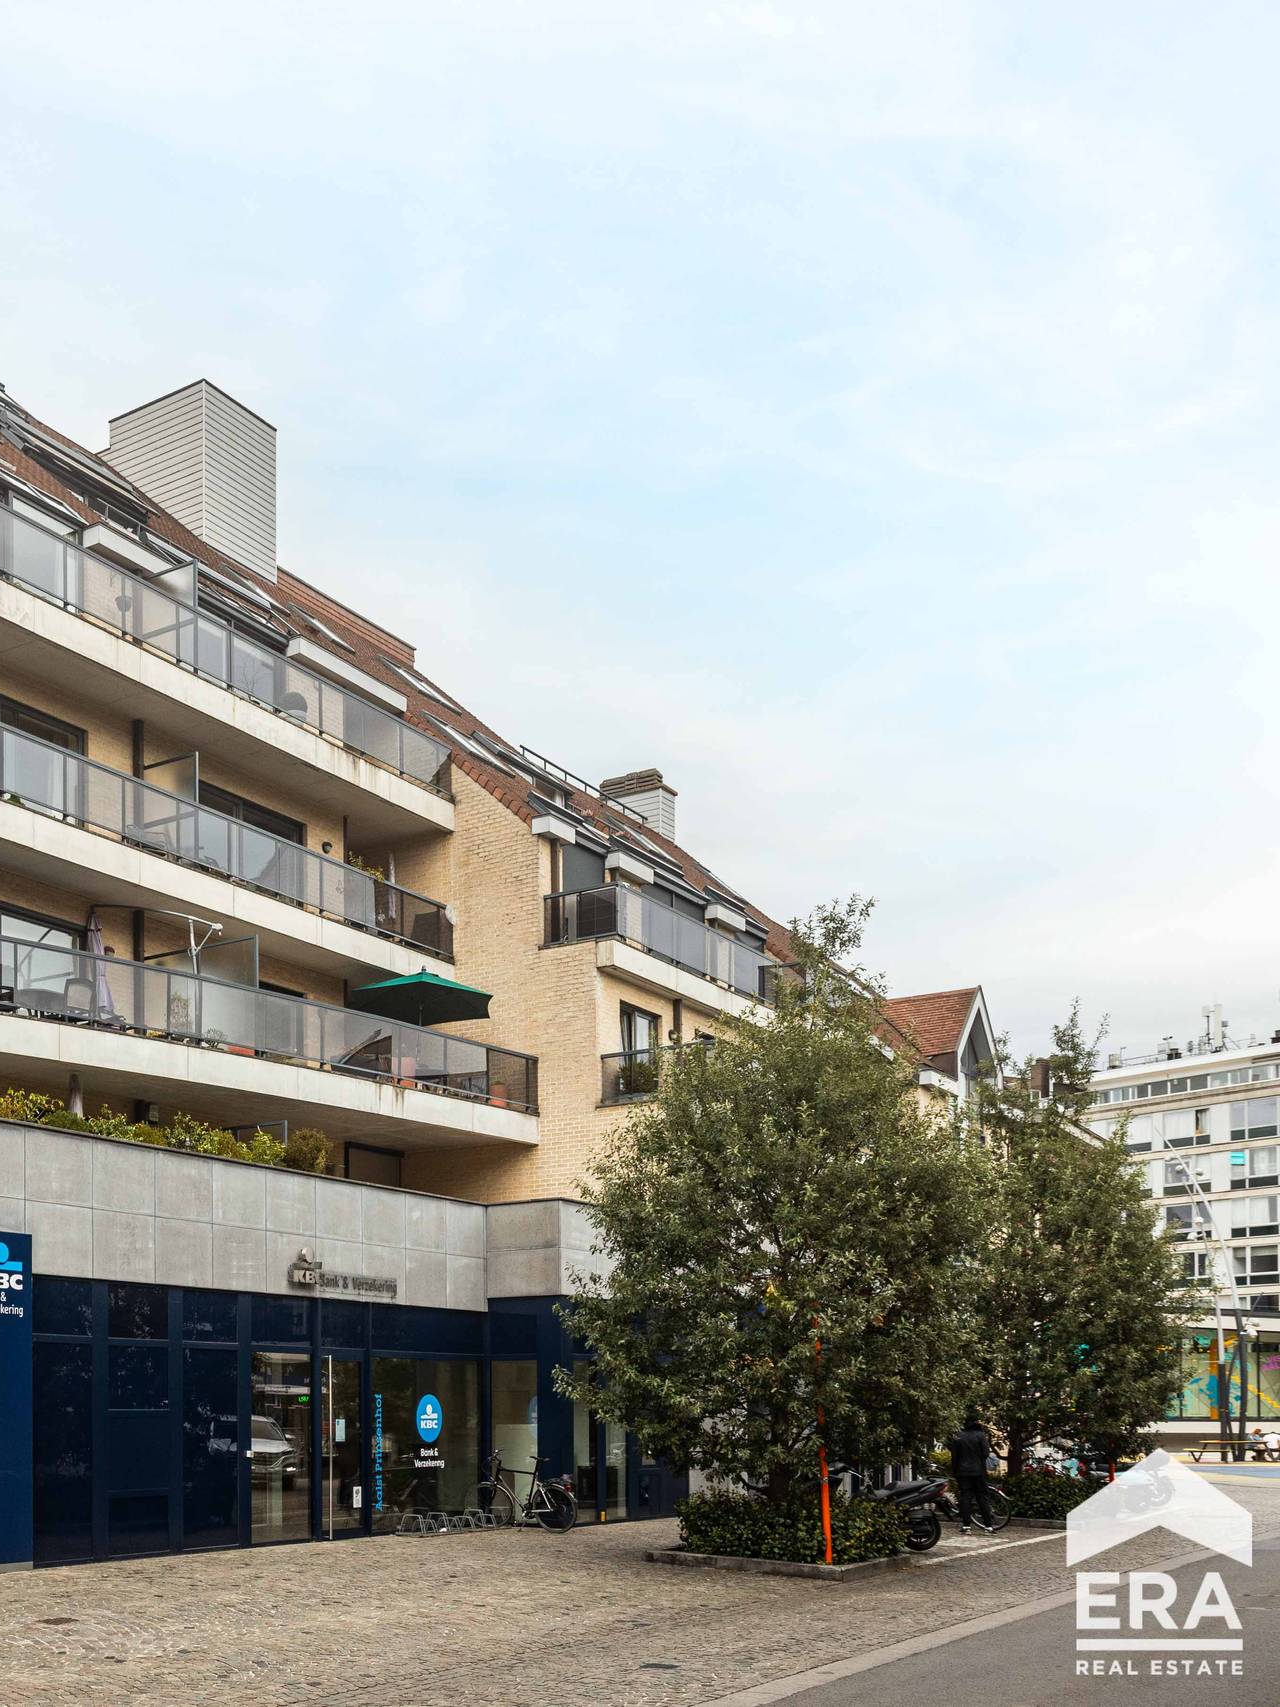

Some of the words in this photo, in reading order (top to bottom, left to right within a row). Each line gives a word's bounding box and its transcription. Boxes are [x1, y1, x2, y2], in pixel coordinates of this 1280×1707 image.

[0, 1291, 7, 1302] &
[420, 1420, 439, 1429] KBC
[374, 1393, 383, 1471] Prinsenhof
[420, 1448, 434, 1457] Bank
[434, 1448, 439, 1456] &
[414, 1459, 445, 1468] Verzekering
[375, 1474, 383, 1512] Aalst
